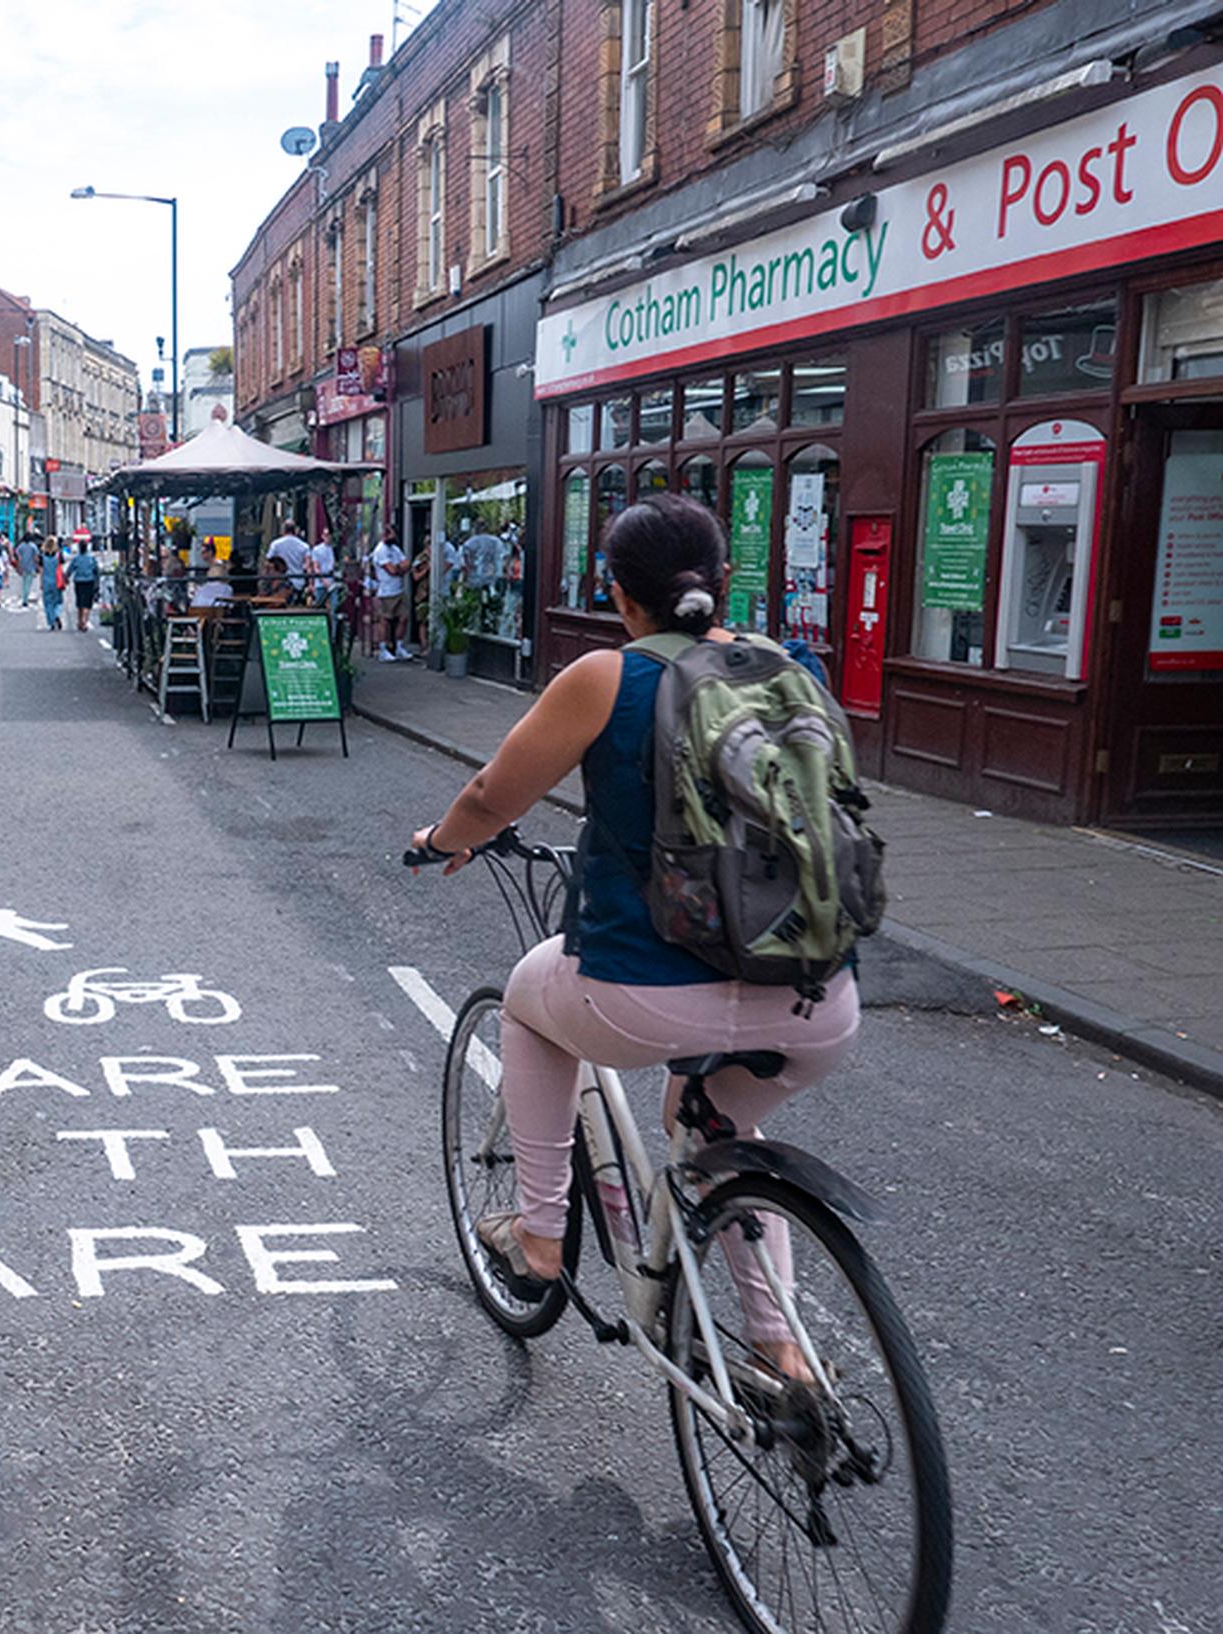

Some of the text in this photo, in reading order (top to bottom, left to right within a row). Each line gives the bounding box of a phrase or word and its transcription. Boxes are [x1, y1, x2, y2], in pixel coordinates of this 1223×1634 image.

[605, 286, 700, 350] Cotham
[710, 221, 888, 321] Pharmacy
[921, 182, 955, 260] &
[997, 122, 1137, 239] Post
